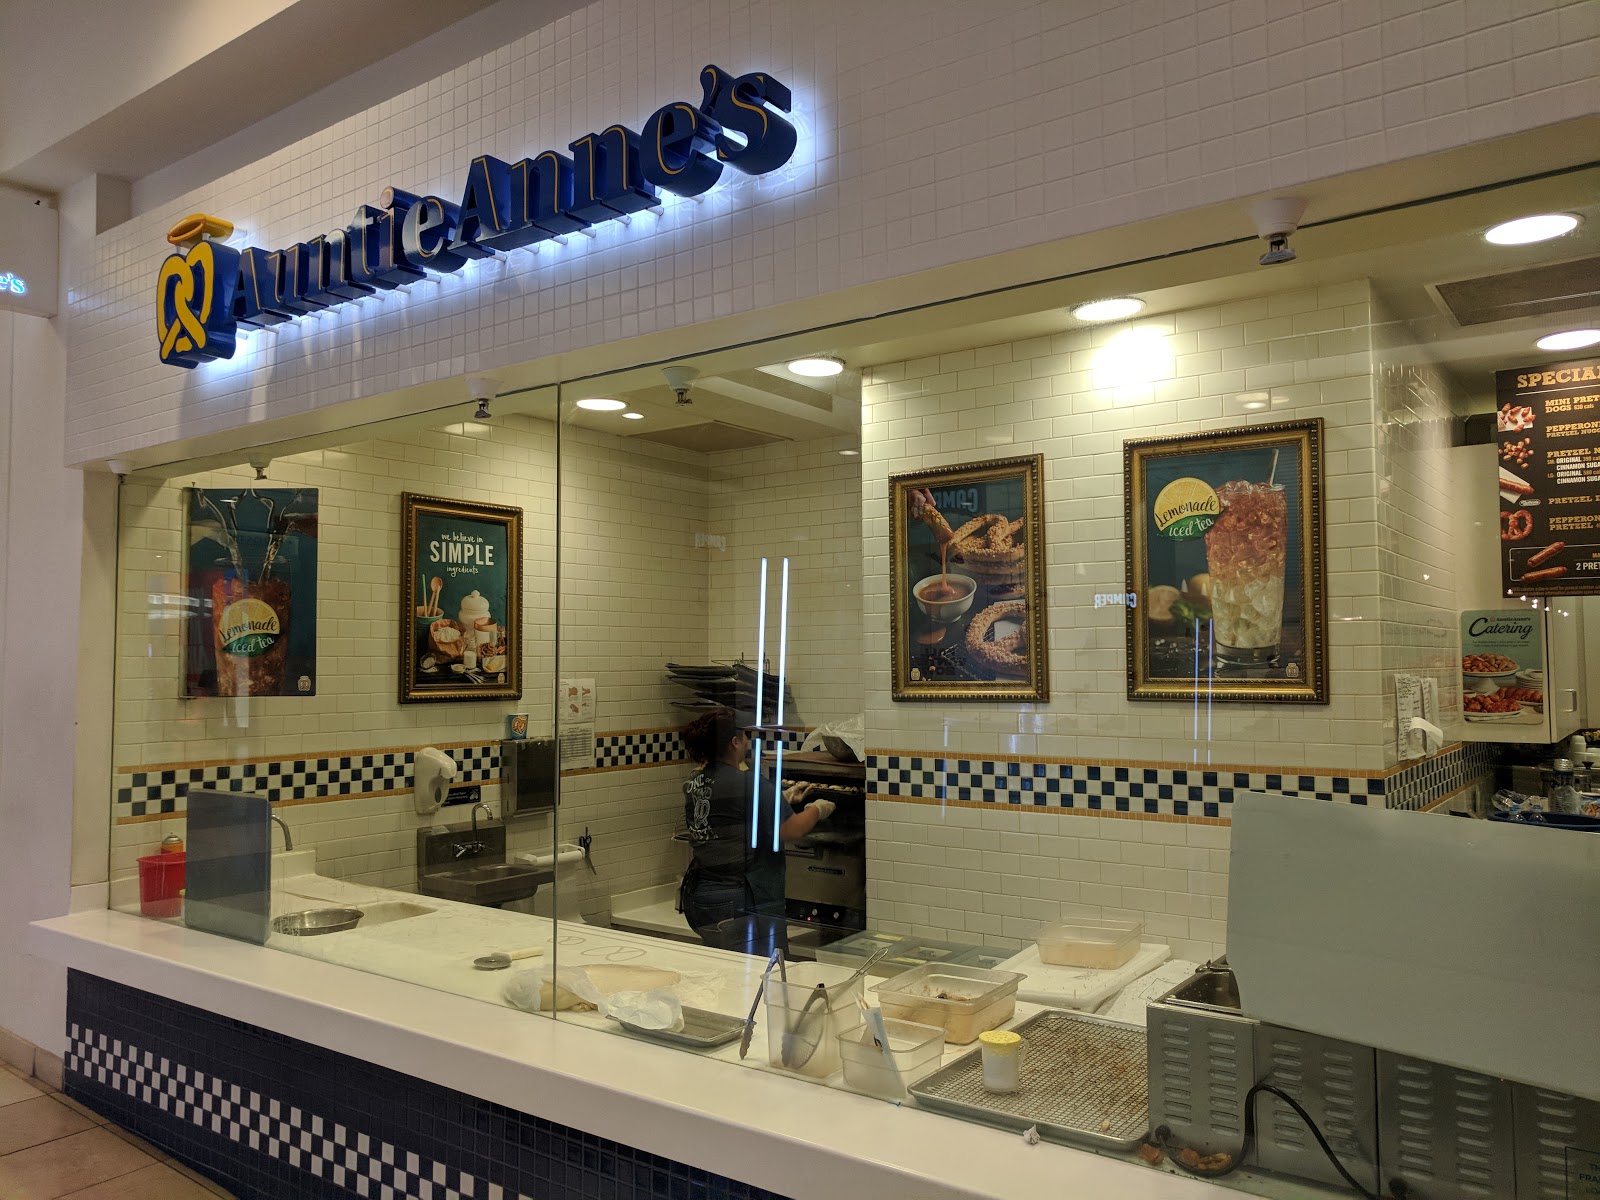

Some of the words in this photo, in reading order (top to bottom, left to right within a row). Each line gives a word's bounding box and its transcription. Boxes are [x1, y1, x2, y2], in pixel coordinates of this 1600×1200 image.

[1517, 366, 1600, 388] SPECIA
[1545, 398, 1571, 406] MINI
[1546, 405, 1571, 413] DOGS
[1546, 421, 1600, 432] PEPPERON
[1547, 448, 1590, 458] PRETZEL
[1548, 495, 1592, 505] PRETZEL
[1155, 496, 1218, 527] Lemonade
[1169, 521, 1194, 536] iced
[1195, 518, 1214, 531] tea
[1549, 522, 1593, 531] PRETZEL
[453, 532, 475, 542] believe
[430, 541, 494, 566] SIMPLE
[447, 566, 478, 577] ingredients
[1576, 562, 1581, 570] 2
[219, 617, 277, 642] Lemonade
[1469, 617, 1533, 639] Catering
[232, 639, 256, 652] iced
[257, 636, 274, 649] tea
